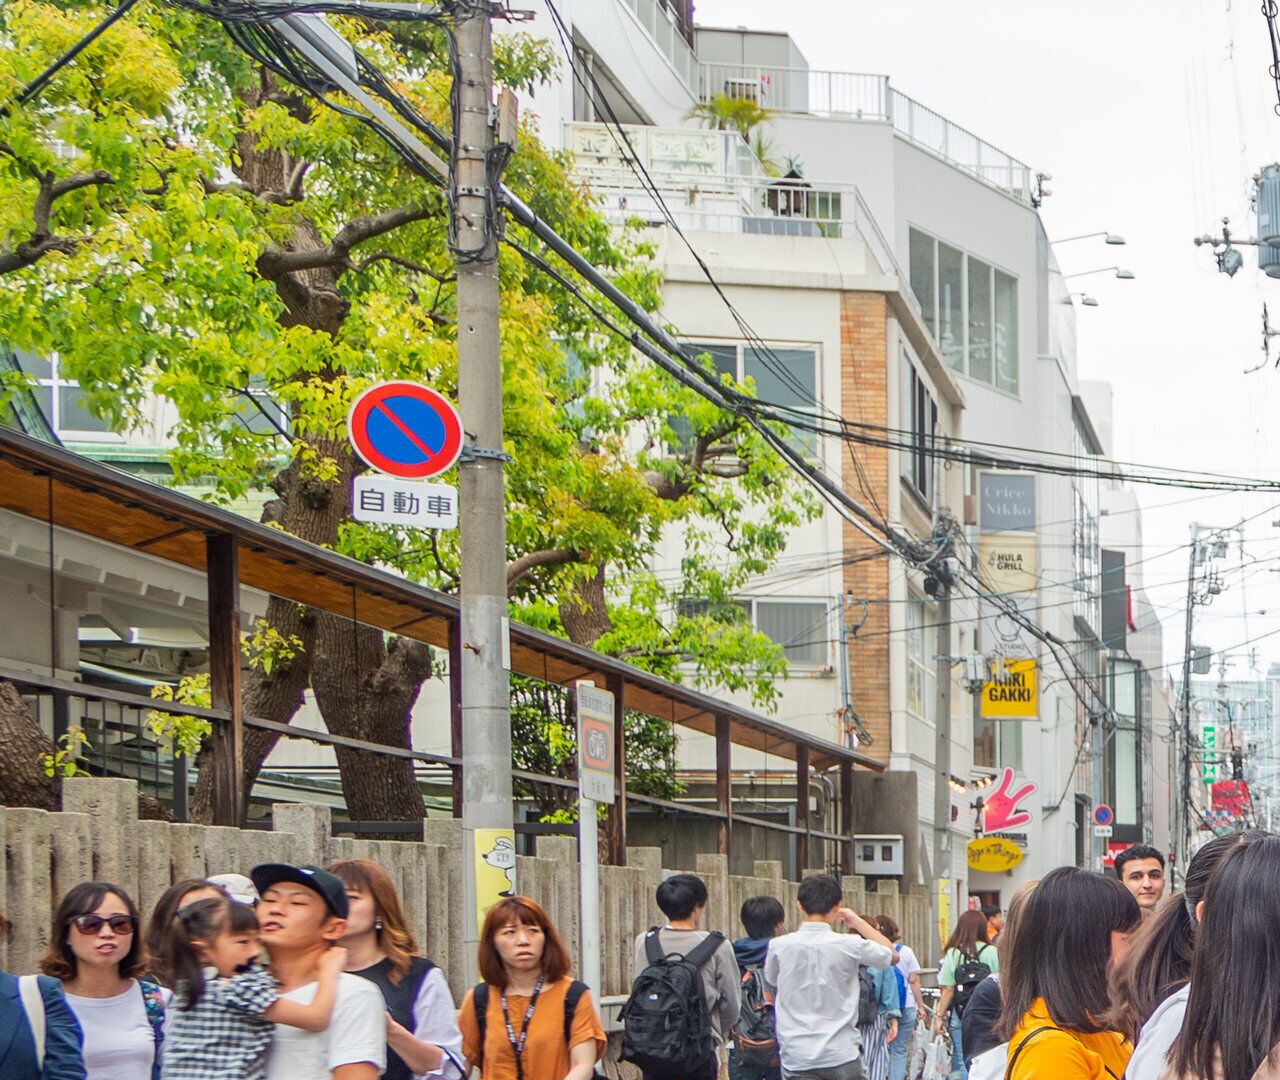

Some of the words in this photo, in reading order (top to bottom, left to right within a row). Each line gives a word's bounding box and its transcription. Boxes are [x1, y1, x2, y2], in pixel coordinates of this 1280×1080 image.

[360, 488, 453, 518] 自動車
[985, 502, 1032, 516] Nikko
[997, 553, 1023, 562] HULA
[997, 563, 1023, 571] GRILL
[989, 687, 1031, 702] GAKKI
